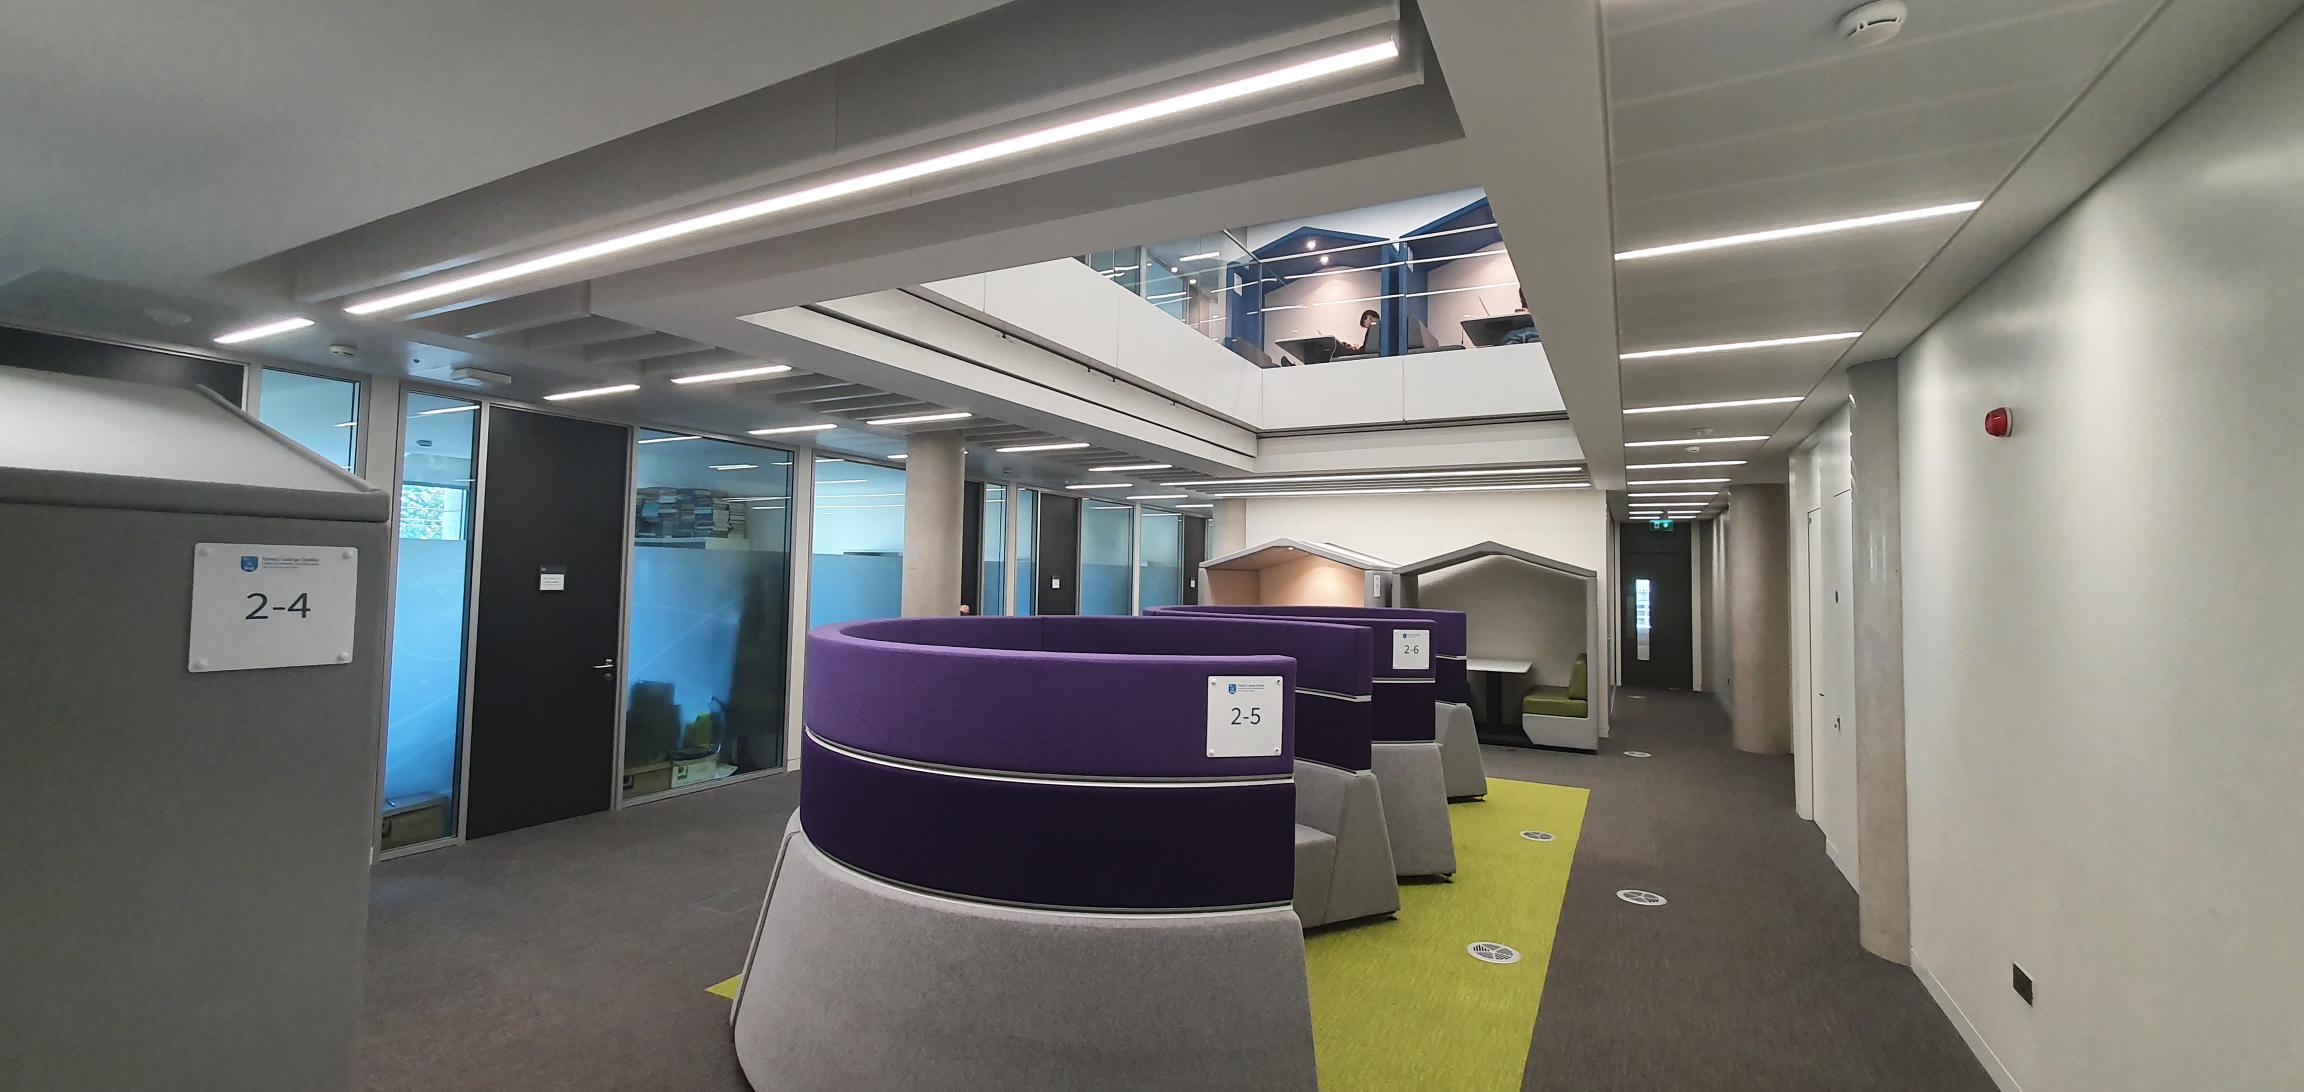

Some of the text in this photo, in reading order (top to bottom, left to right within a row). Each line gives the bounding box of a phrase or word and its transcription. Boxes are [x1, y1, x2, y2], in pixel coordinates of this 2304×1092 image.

[245, 592, 311, 620] 2-4
[1404, 644, 1419, 654] 2-6
[1231, 707, 1261, 725] 2-5
